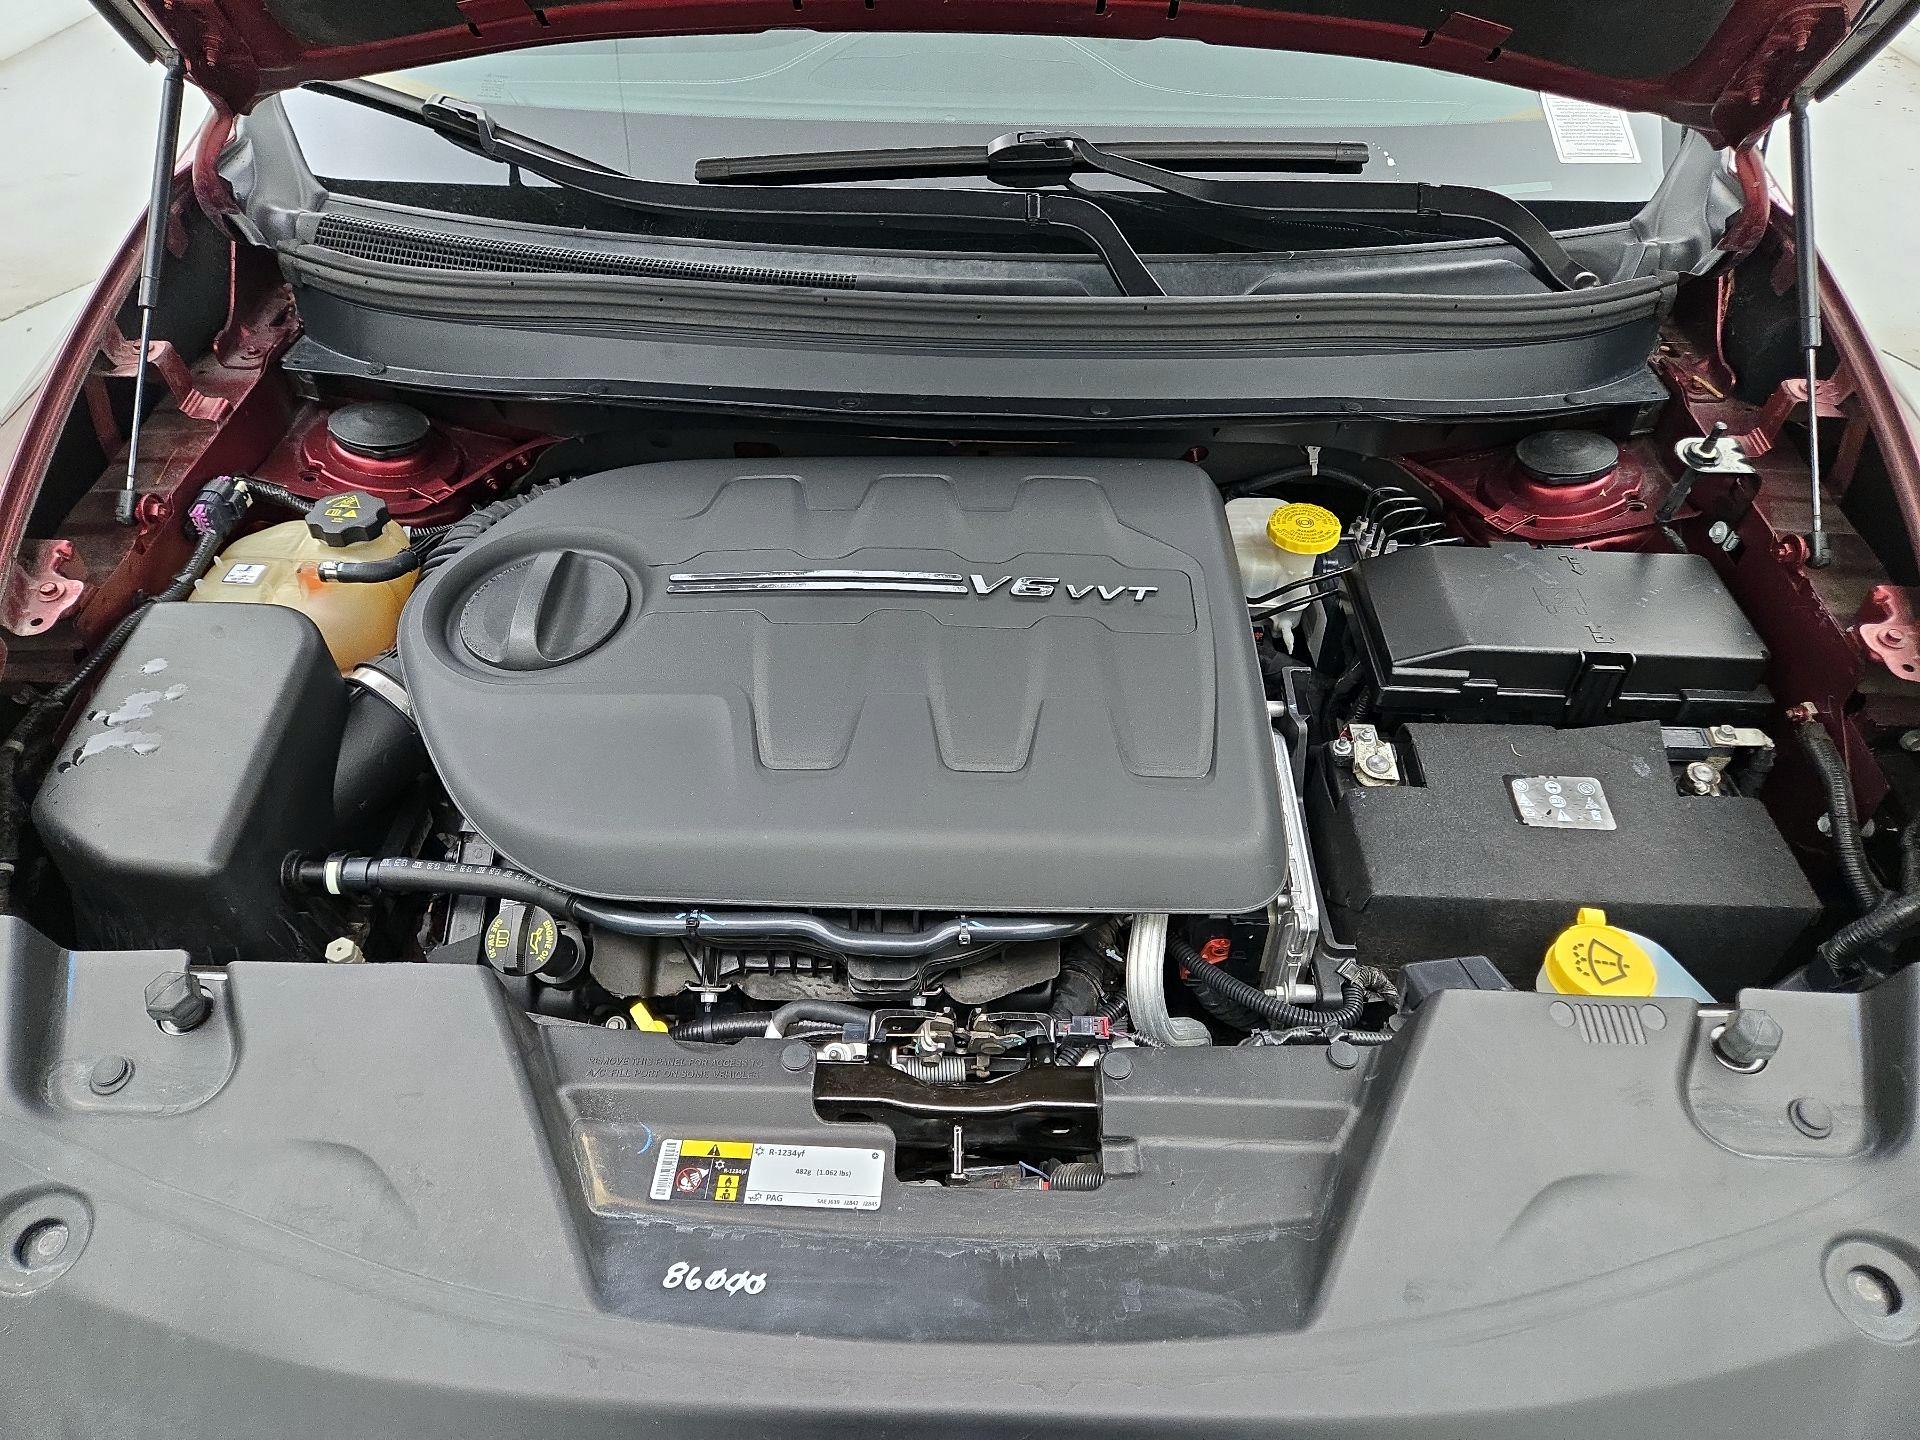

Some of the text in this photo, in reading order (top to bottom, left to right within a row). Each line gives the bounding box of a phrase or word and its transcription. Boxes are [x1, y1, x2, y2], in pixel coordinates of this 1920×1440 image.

[970, 574, 1159, 602] V6 VVT
[488, 919, 503, 958] SAE 5W-20
[536, 920, 553, 962] ENGINE OIL
[632, 1057, 653, 1066] THIS
[655, 1058, 686, 1067] PANEL
[688, 1058, 709, 1067] FOR
[711, 1058, 749, 1068] ACCESS
[751, 1059, 764, 1068] TO
[585, 1067, 607, 1078] A/C
[609, 1068, 631, 1078] FILL
[634, 1069, 661, 1078] PORT
[663, 1069, 680, 1078] ON
[768, 1148, 806, 1159] R-1234yf
[723, 1167, 748, 1175] R-1234yf
[794, 1167, 852, 1178] 482g (1.062 lbs)
[765, 1193, 783, 1202] PAG
